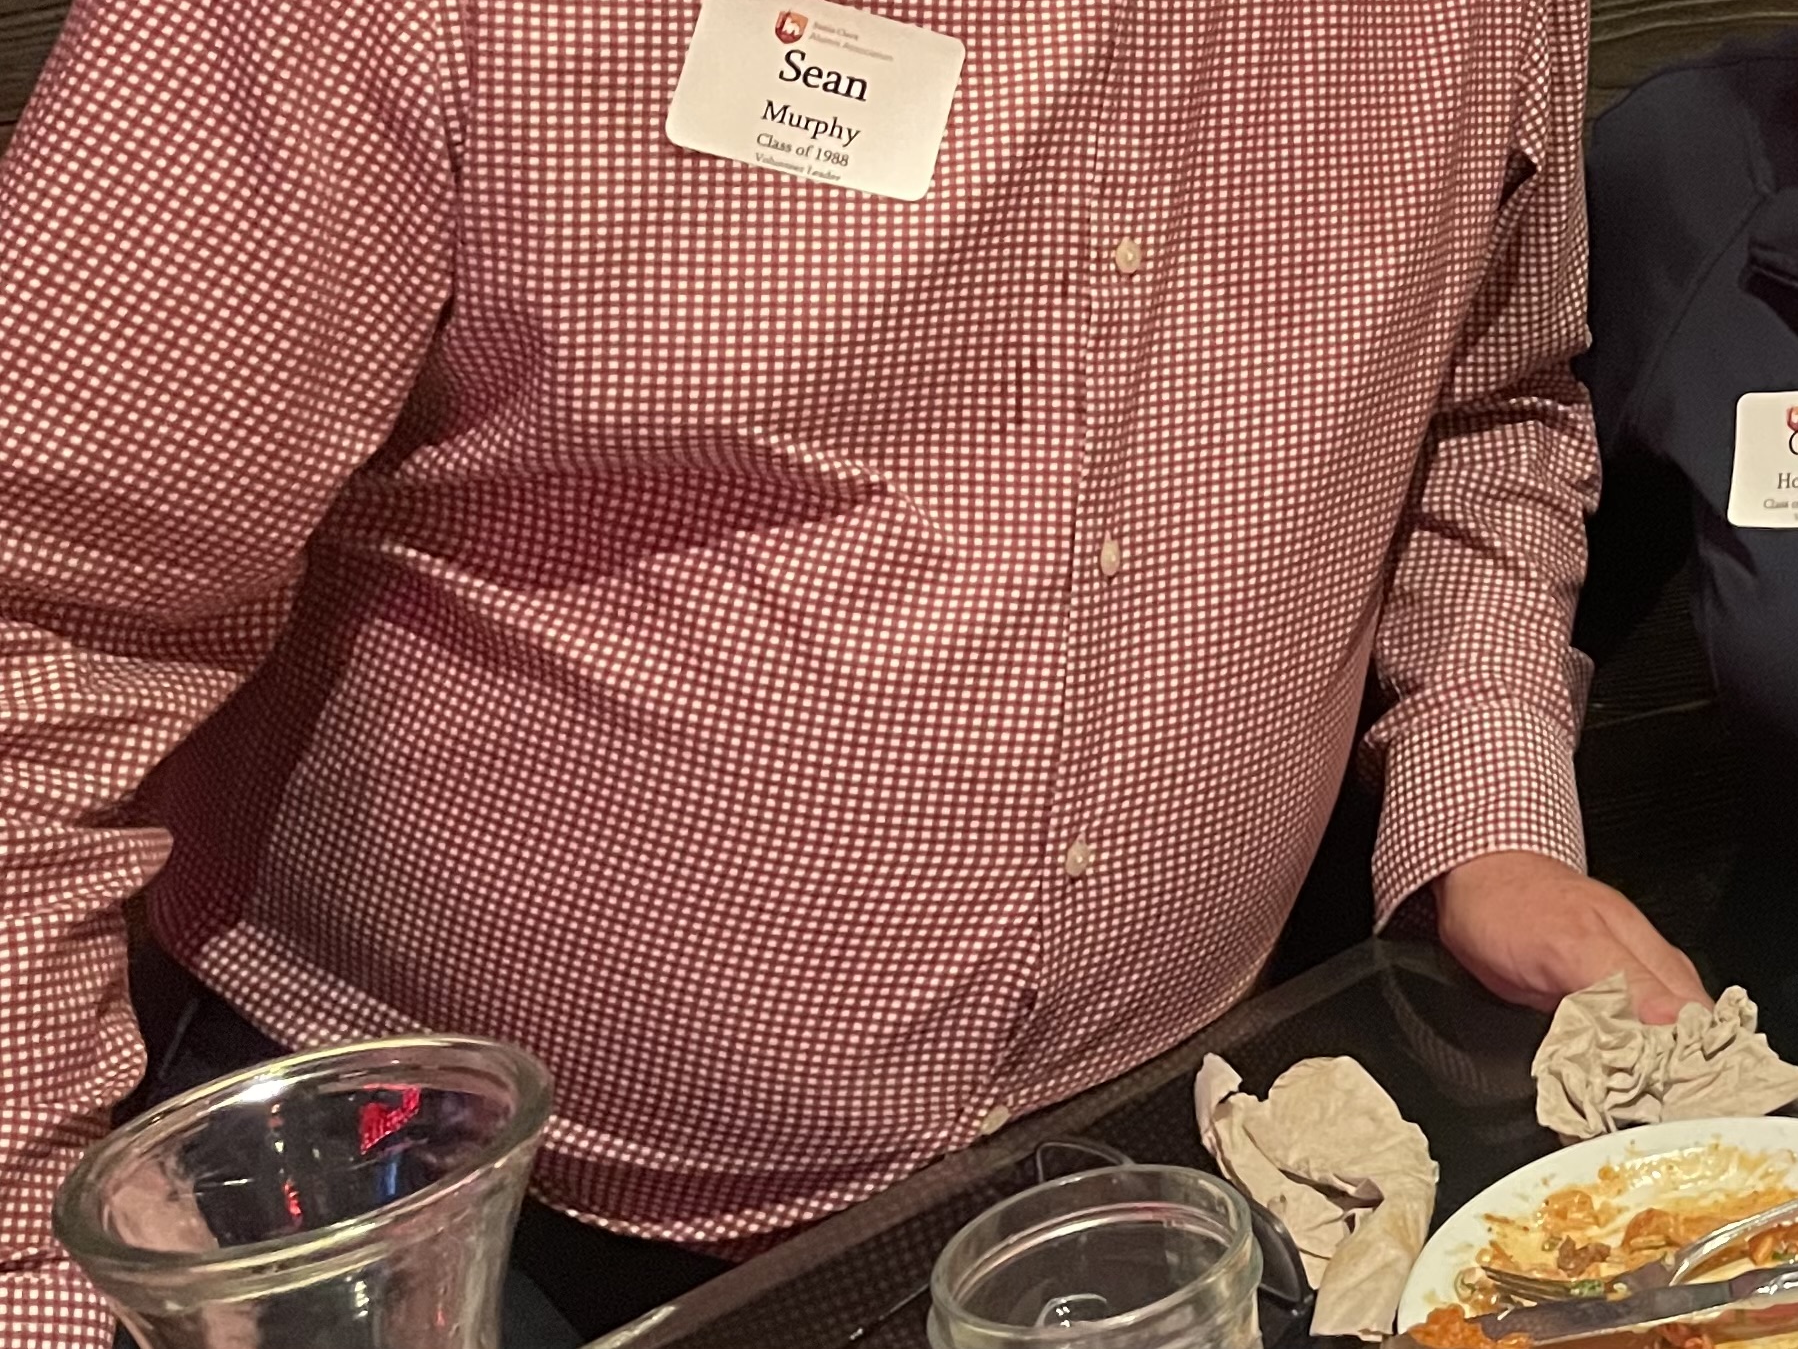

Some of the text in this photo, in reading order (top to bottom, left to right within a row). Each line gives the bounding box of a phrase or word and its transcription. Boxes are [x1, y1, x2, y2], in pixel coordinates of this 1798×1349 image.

[778, 49, 868, 102] Sean
[760, 99, 861, 147] Murphy
[756, 133, 850, 167] Class of 1988
[1763, 498, 1789, 509] Class
